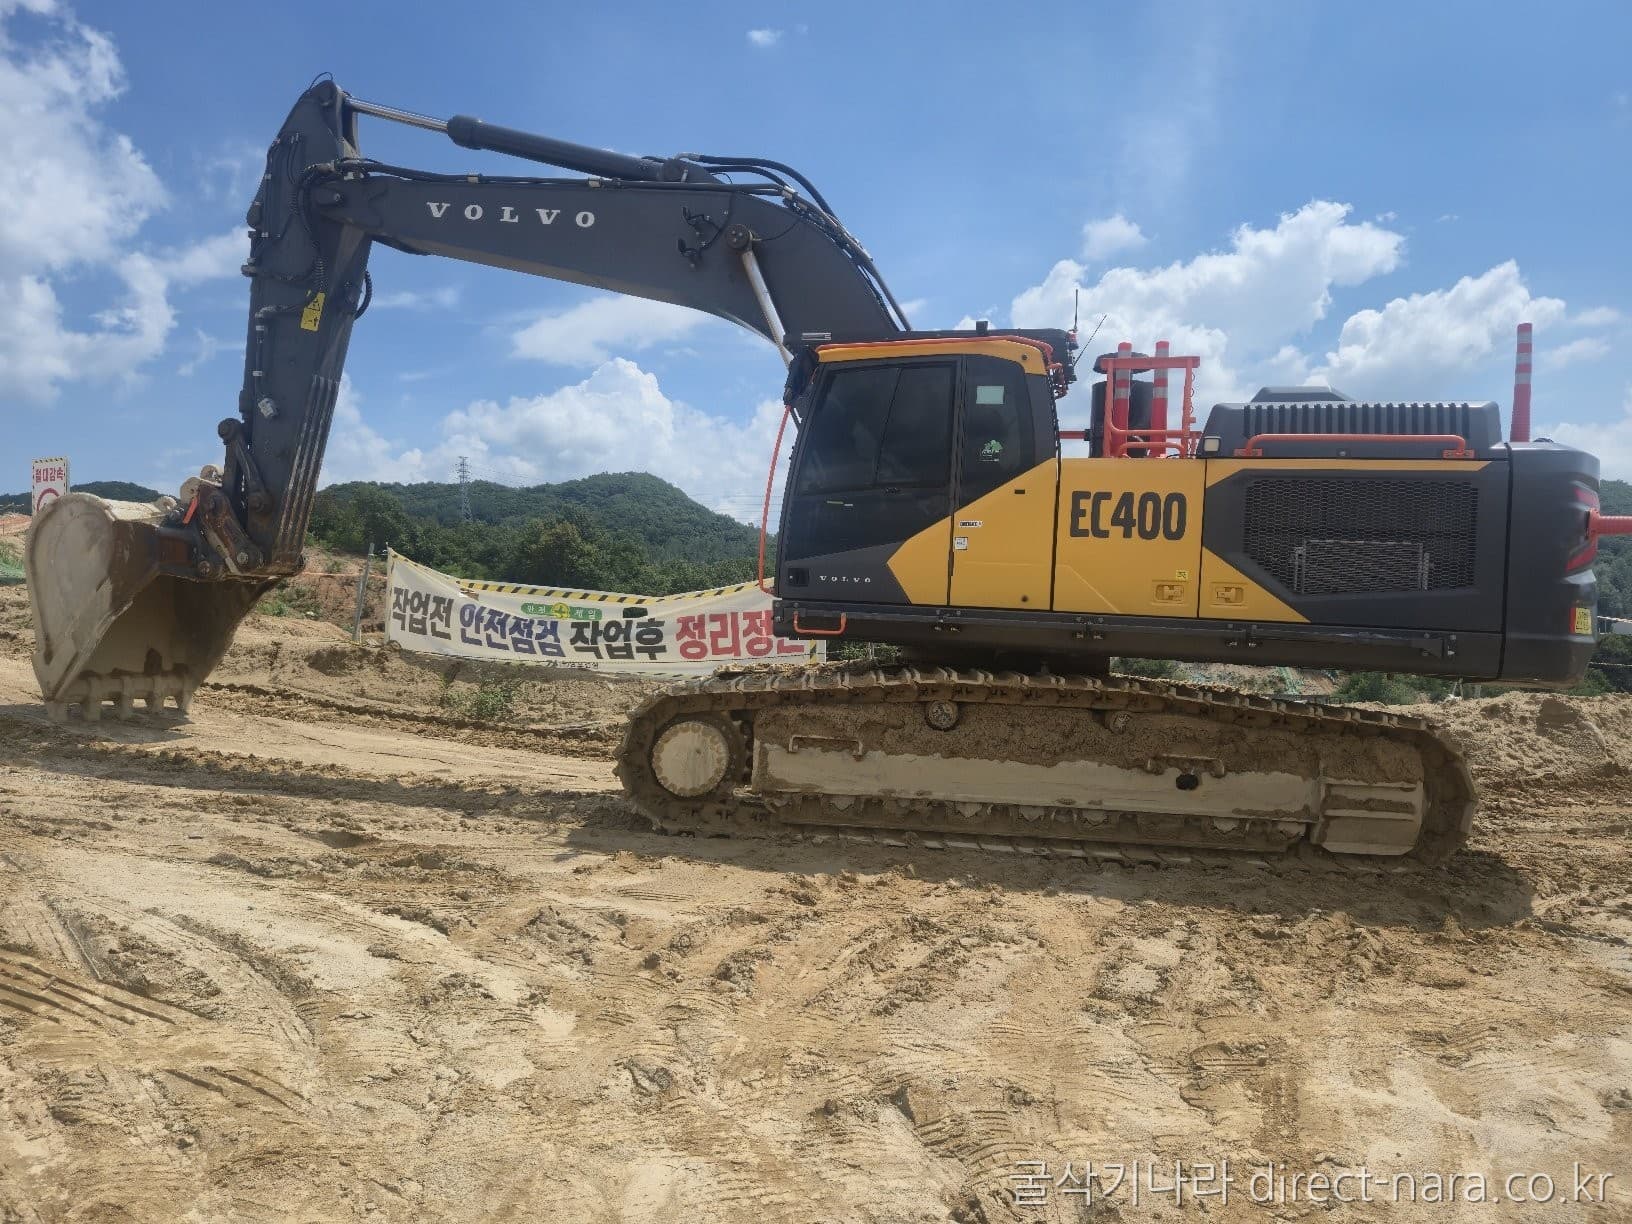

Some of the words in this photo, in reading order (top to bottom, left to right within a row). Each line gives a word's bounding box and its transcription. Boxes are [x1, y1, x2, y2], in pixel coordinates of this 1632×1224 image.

[426, 201, 596, 229] VOLVO
[35, 467, 64, 483] 절대감속
[1069, 490, 1188, 541] EC400
[819, 575, 872, 583] VOLVO
[392, 586, 455, 640] 작업전
[459, 603, 566, 657] 안전점검
[569, 617, 667, 660] 작업후
